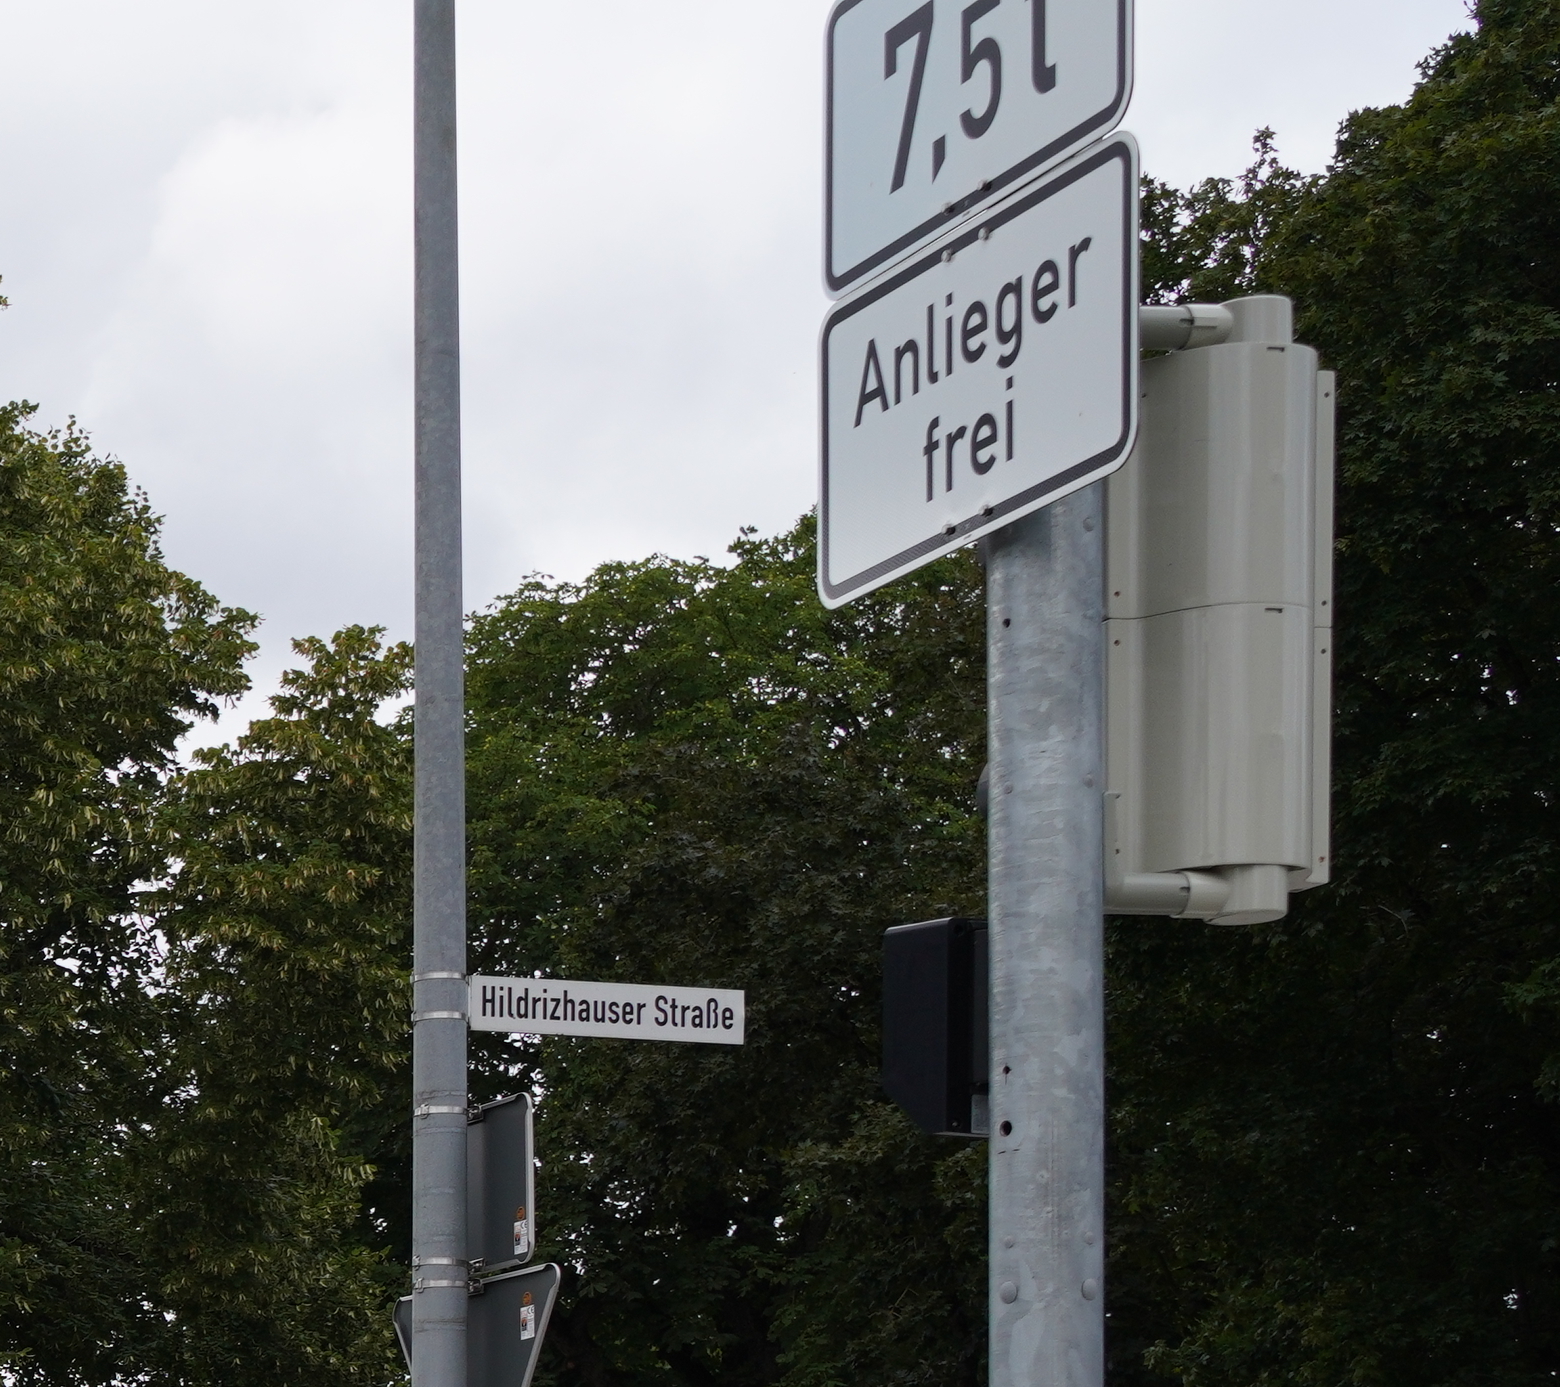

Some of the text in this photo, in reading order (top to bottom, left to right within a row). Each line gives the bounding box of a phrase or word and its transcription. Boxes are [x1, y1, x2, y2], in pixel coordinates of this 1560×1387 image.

[852, 236, 1093, 429] Anlieger
[922, 377, 1015, 503] frei
[481, 985, 735, 1030] Hildrizhauser Straße
